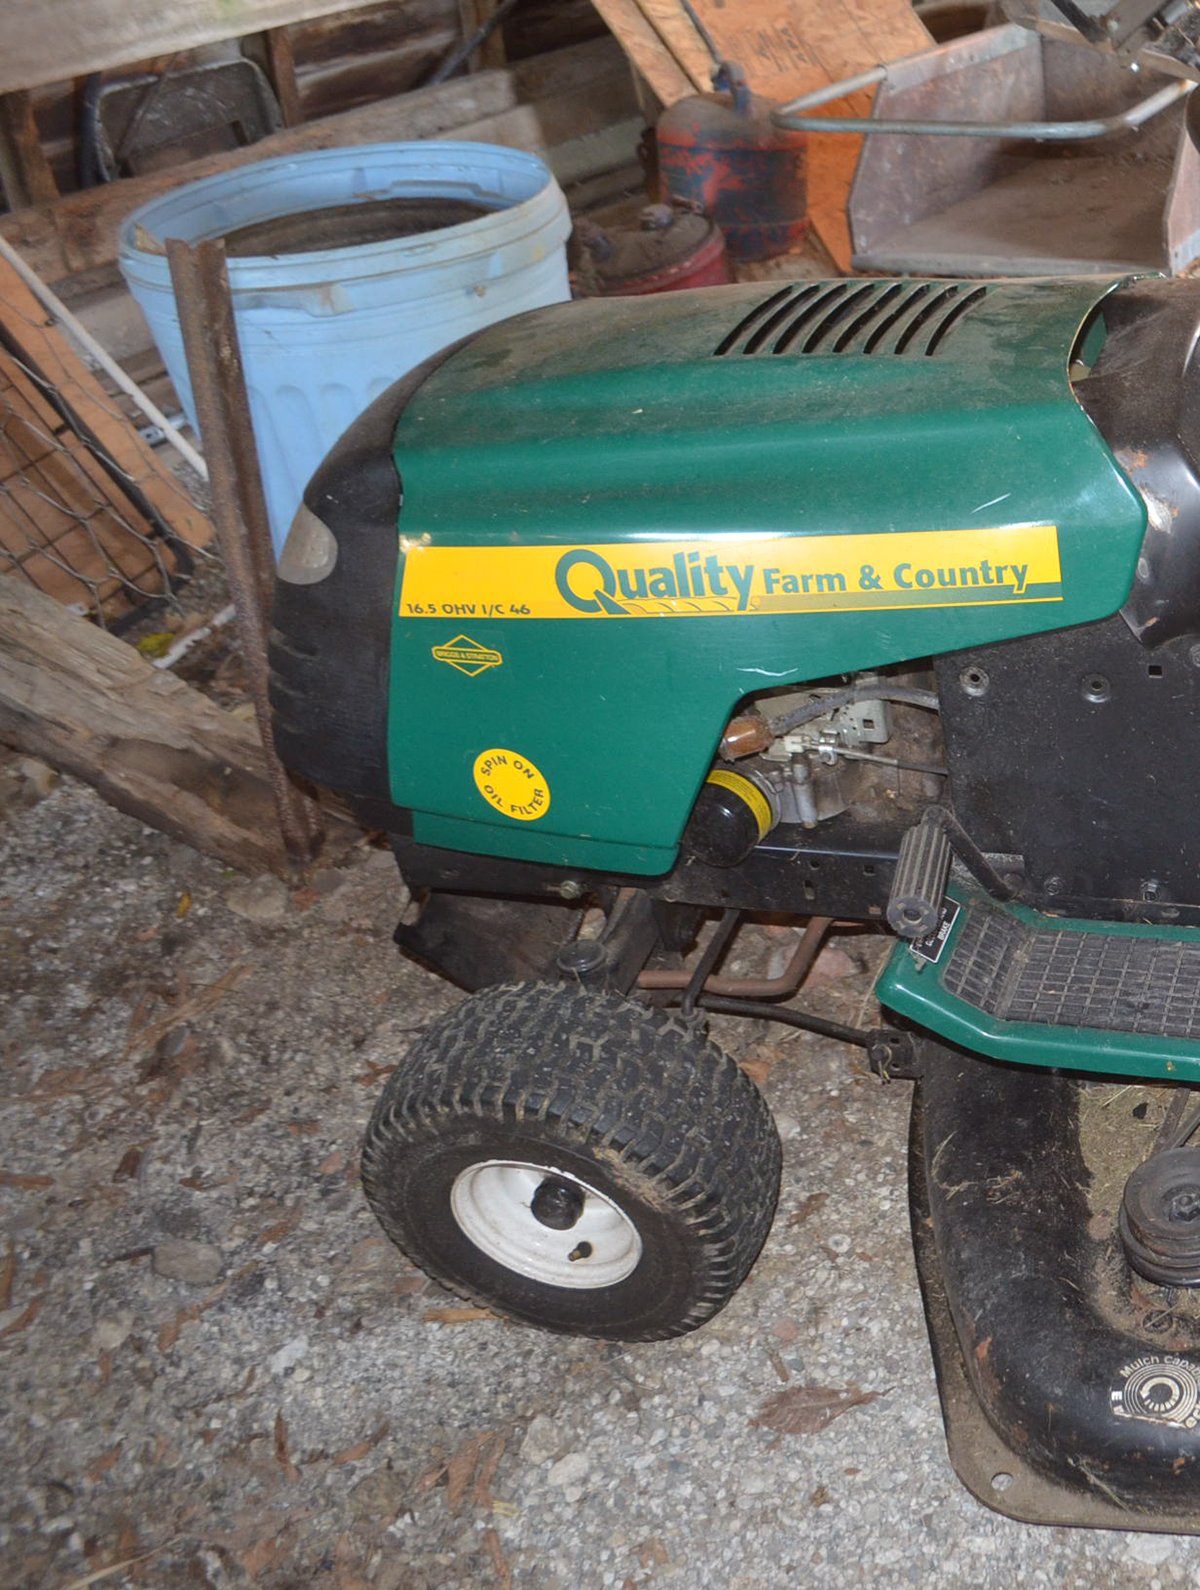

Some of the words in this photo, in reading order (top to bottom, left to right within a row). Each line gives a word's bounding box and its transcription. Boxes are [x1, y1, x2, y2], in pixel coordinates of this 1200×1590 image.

[555, 549, 754, 615] Quality
[762, 568, 847, 594] Farm
[858, 564, 883, 590] &
[893, 560, 1028, 593] Country
[406, 603, 437, 615] 16.5
[441, 603, 476, 616] OHV
[481, 603, 505, 617] I/C
[509, 603, 531, 616] 46
[480, 755, 508, 776] SPIN
[513, 760, 535, 779] ON
[484, 784, 504, 808] OIL
[510, 788, 544, 815] FILTER
[1119, 1354, 1160, 1379] Mulch
